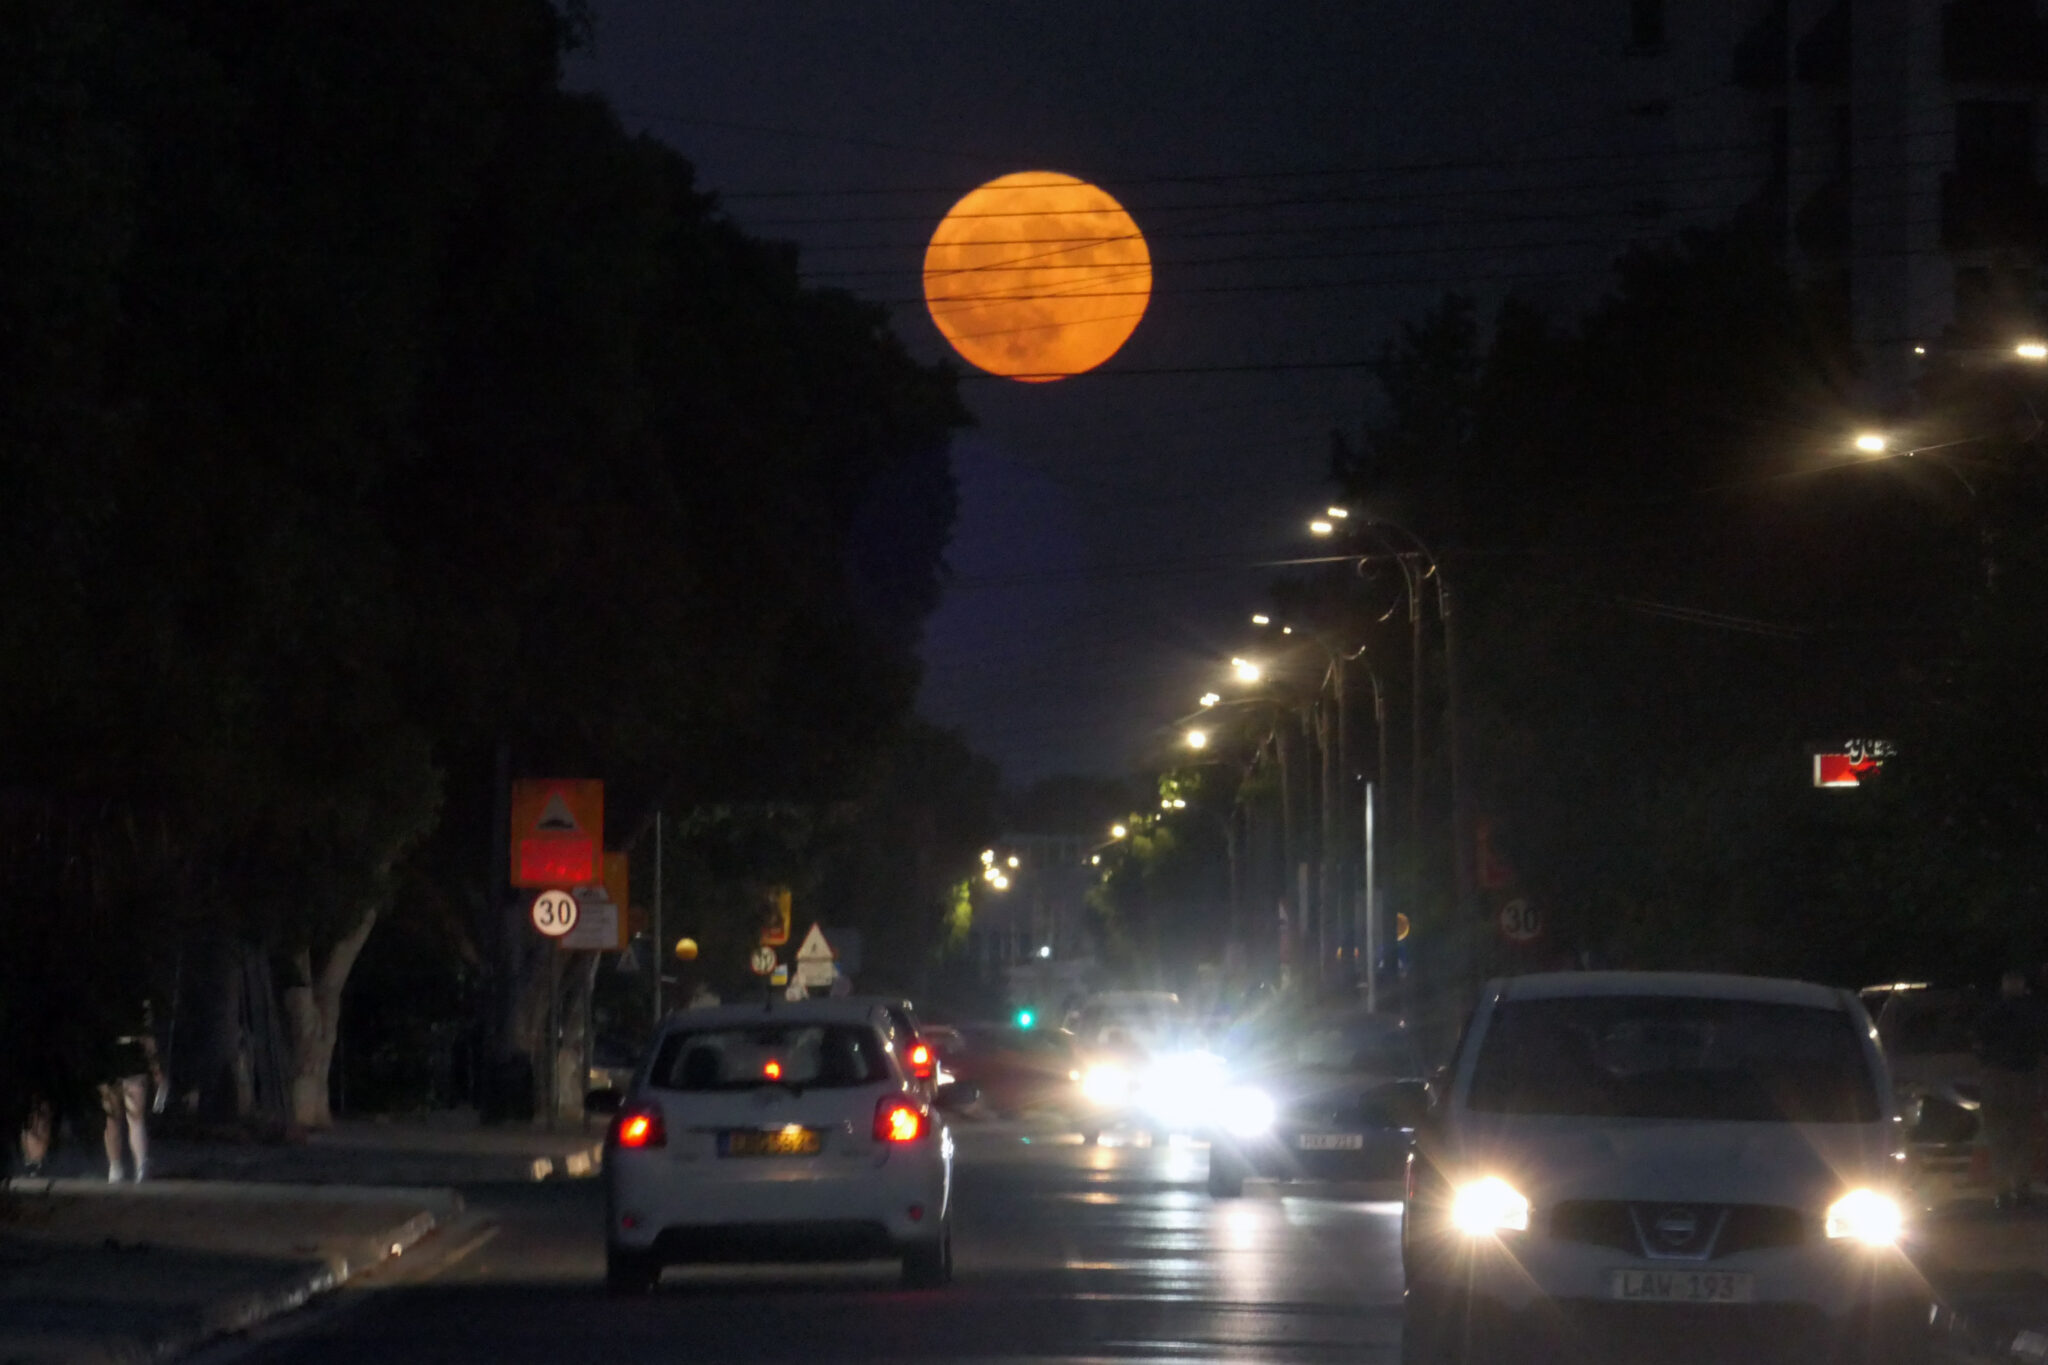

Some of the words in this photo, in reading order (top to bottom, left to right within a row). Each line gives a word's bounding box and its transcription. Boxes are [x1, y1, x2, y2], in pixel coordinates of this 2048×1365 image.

[539, 899, 573, 926] 30
[1506, 906, 1537, 933] 30
[1623, 1272, 1673, 1298] LAW
[1687, 1274, 1735, 1300] 193
